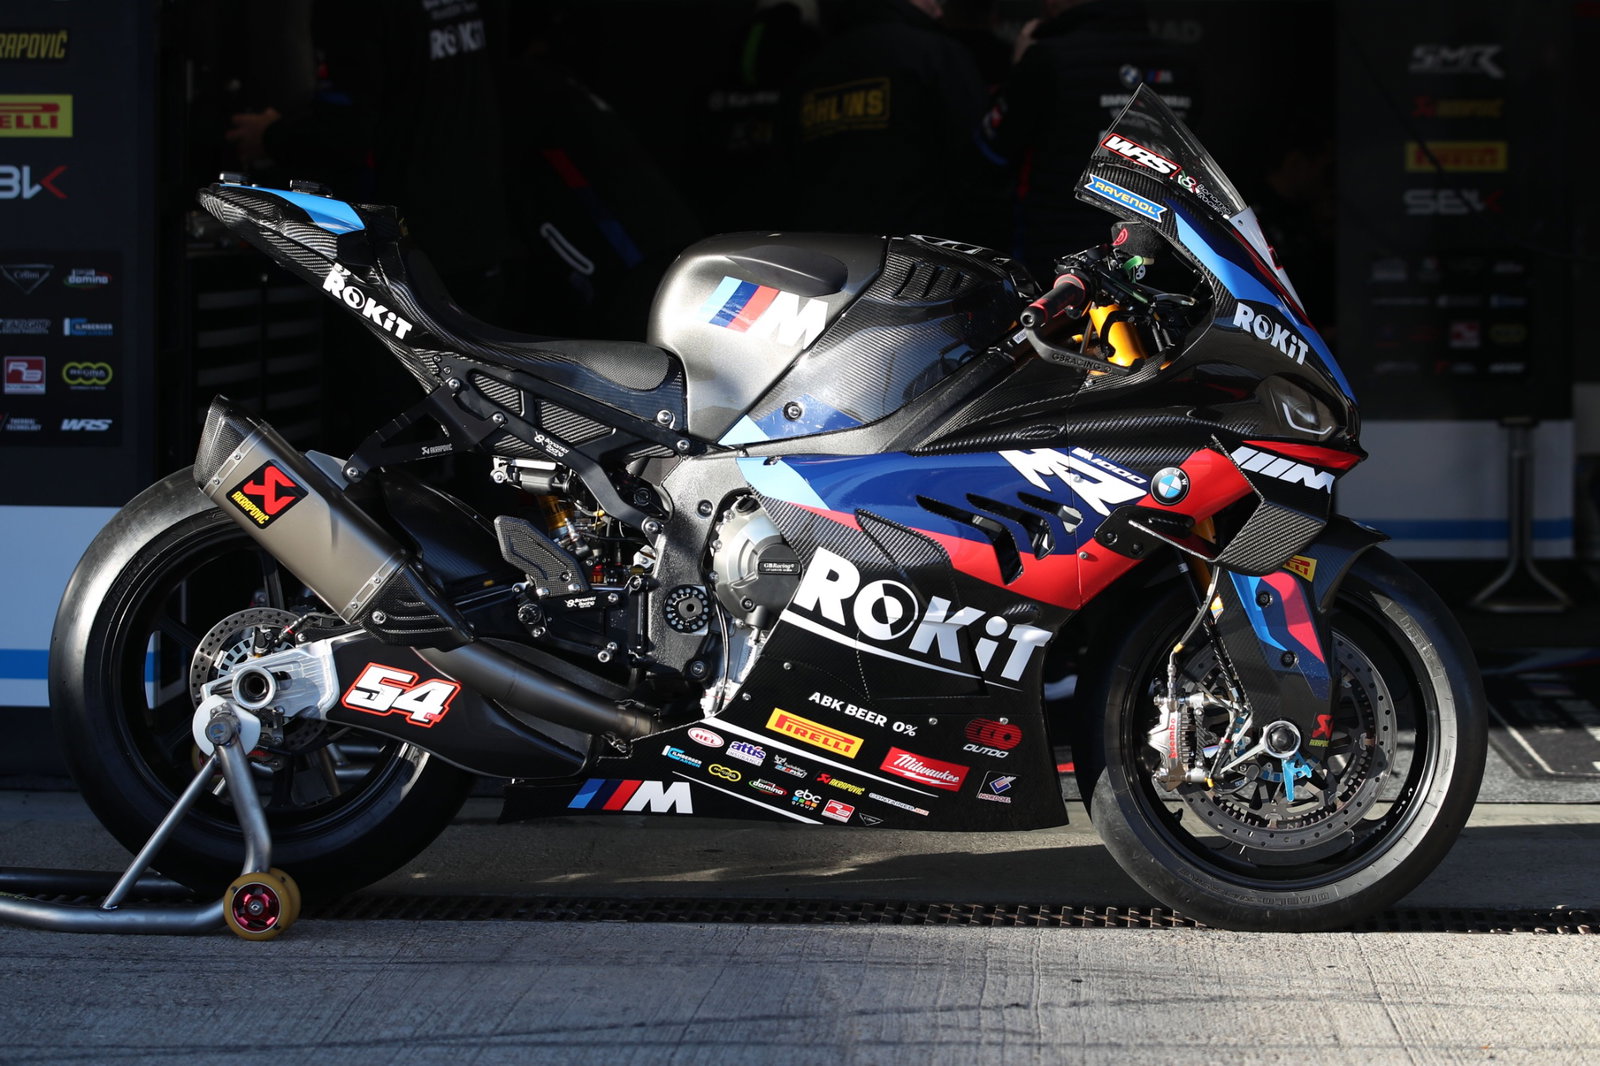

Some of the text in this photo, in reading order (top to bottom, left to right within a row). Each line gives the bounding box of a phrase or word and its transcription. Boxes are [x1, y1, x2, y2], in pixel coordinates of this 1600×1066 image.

[1105, 136, 1177, 175] WRS
[1095, 180, 1157, 216] RAVENOL
[341, 662, 461, 728] 54
[808, 692, 918, 737] ABK BEER 0%
[773, 714, 856, 754] PIRELLI
[963, 743, 1009, 759] OUTDO
[1168, 717, 1177, 759] brembo
[893, 753, 960, 783] Milwaukee
[795, 788, 822, 804] ebc
